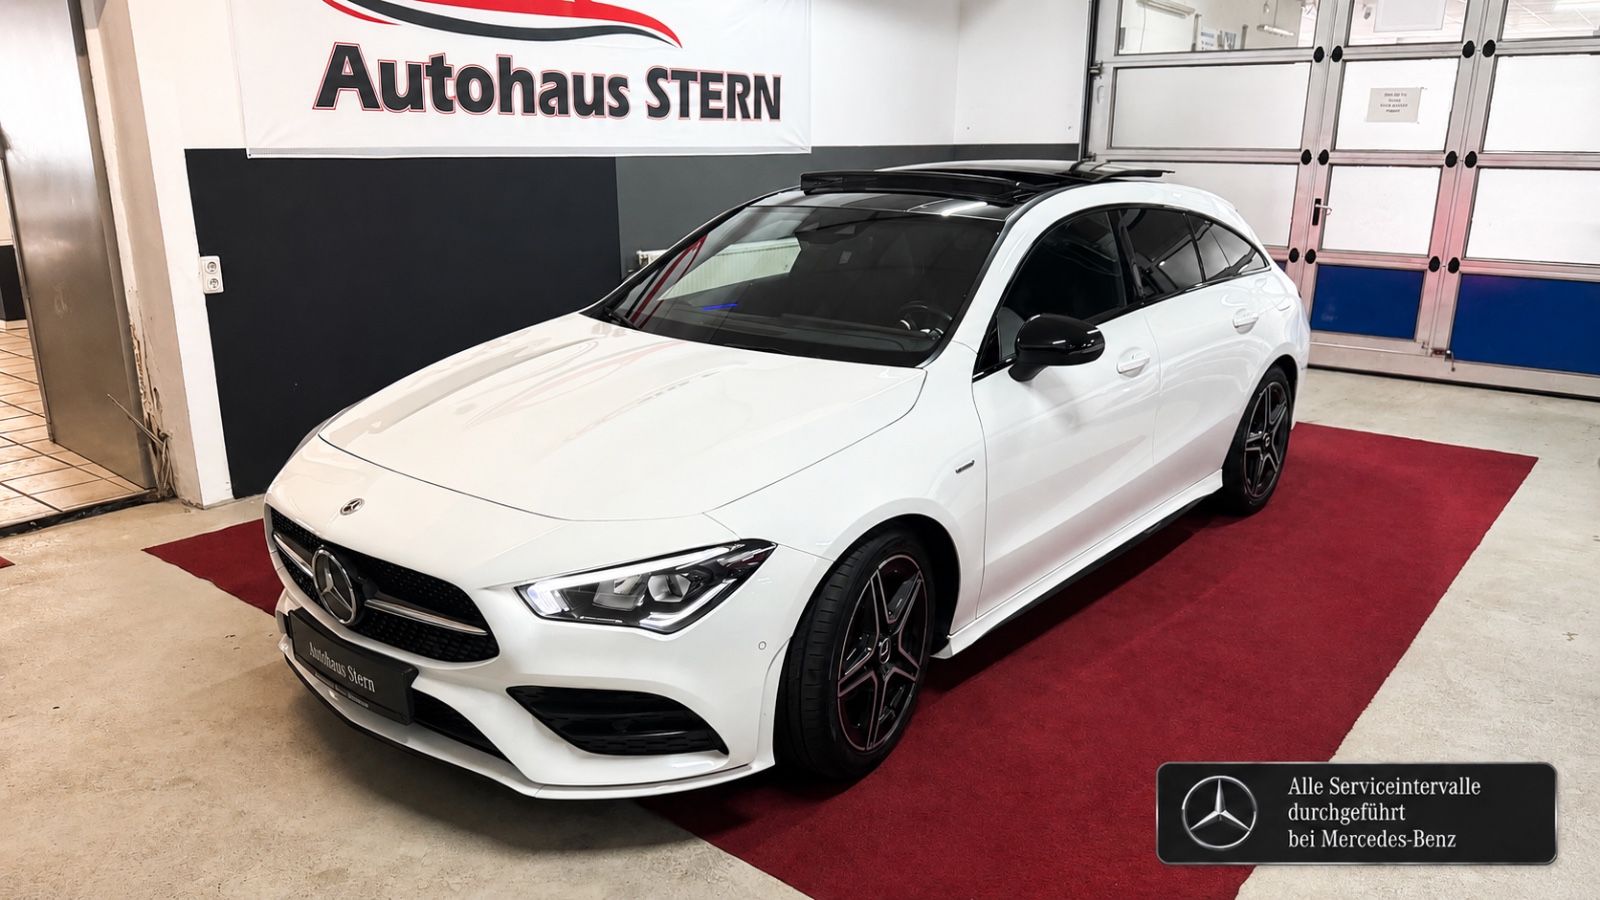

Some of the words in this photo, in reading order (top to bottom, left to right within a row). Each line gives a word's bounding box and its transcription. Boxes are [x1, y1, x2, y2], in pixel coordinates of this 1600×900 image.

[312, 41, 630, 119] Autohaus
[646, 65, 783, 121] STERN
[347, 664, 376, 693] Stern
